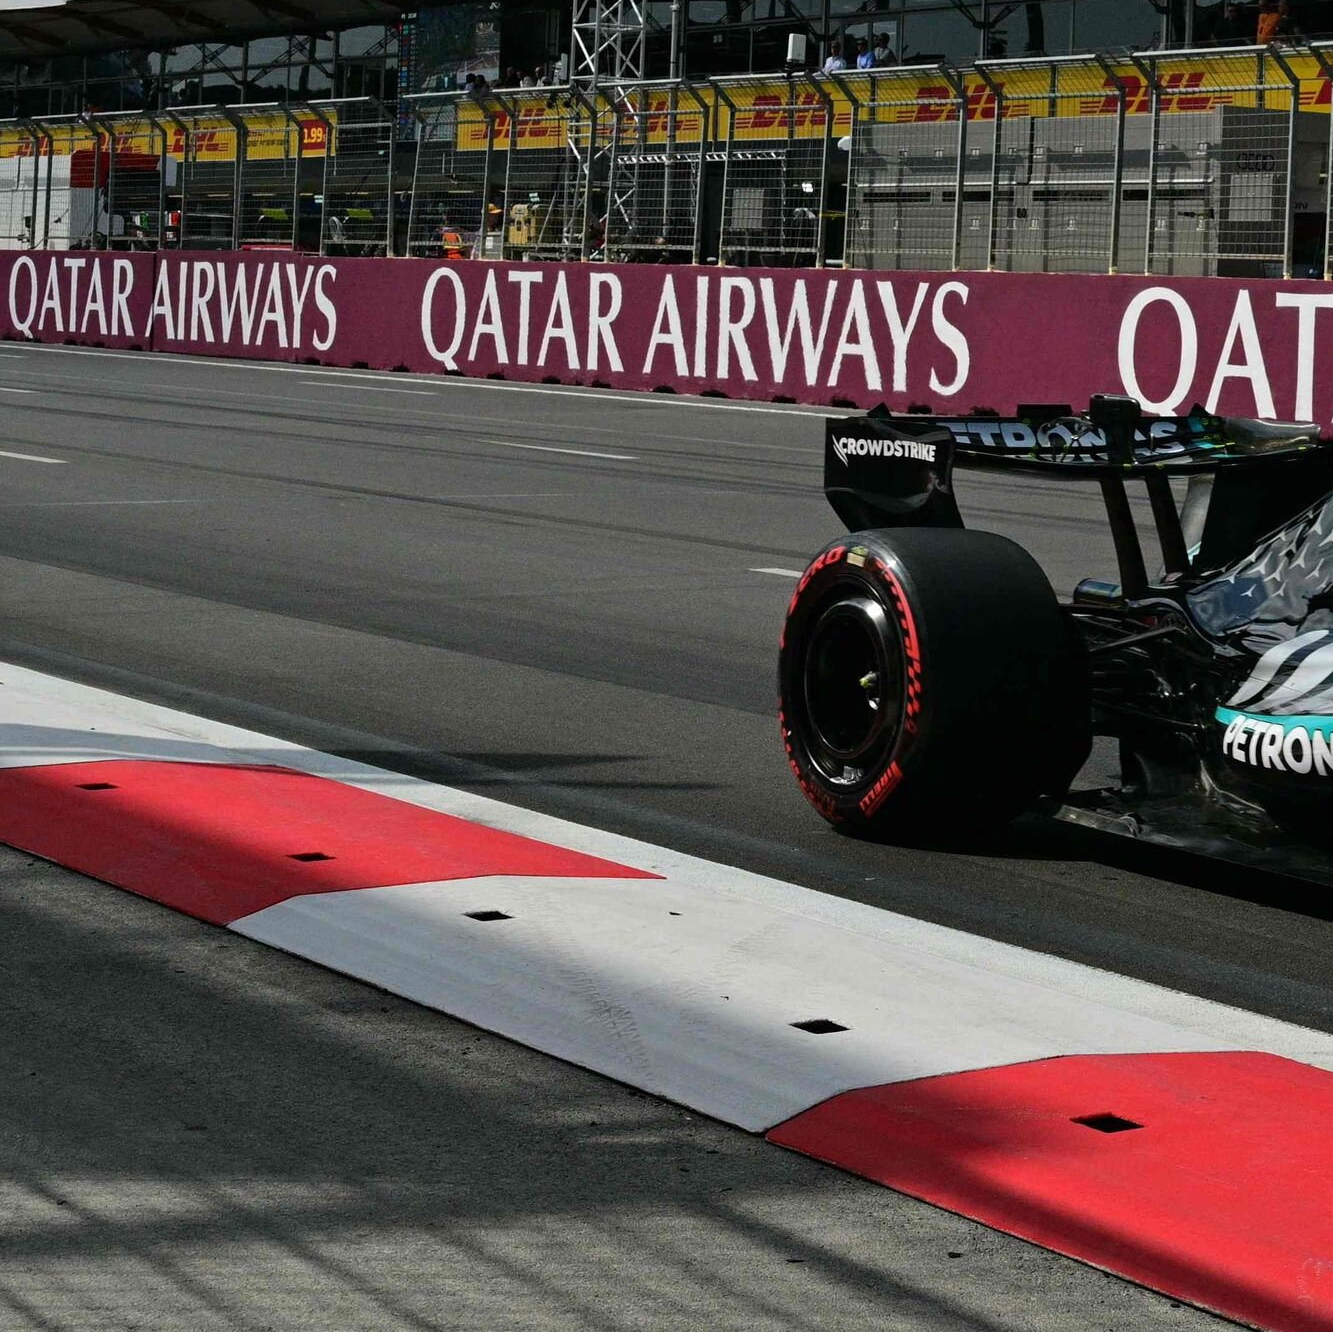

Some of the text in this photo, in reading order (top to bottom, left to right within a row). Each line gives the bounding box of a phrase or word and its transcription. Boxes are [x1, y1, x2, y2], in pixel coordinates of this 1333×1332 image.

[750, 92, 834, 128] DHL
[913, 84, 1006, 121] DHL
[1100, 71, 1211, 114] DHL
[482, 107, 550, 140] DHL
[9, 255, 338, 352] QATAR AIRWAYS
[421, 268, 971, 396] QATAR AIRWAYS
[839, 437, 936, 463] CROWDSTRIKE
